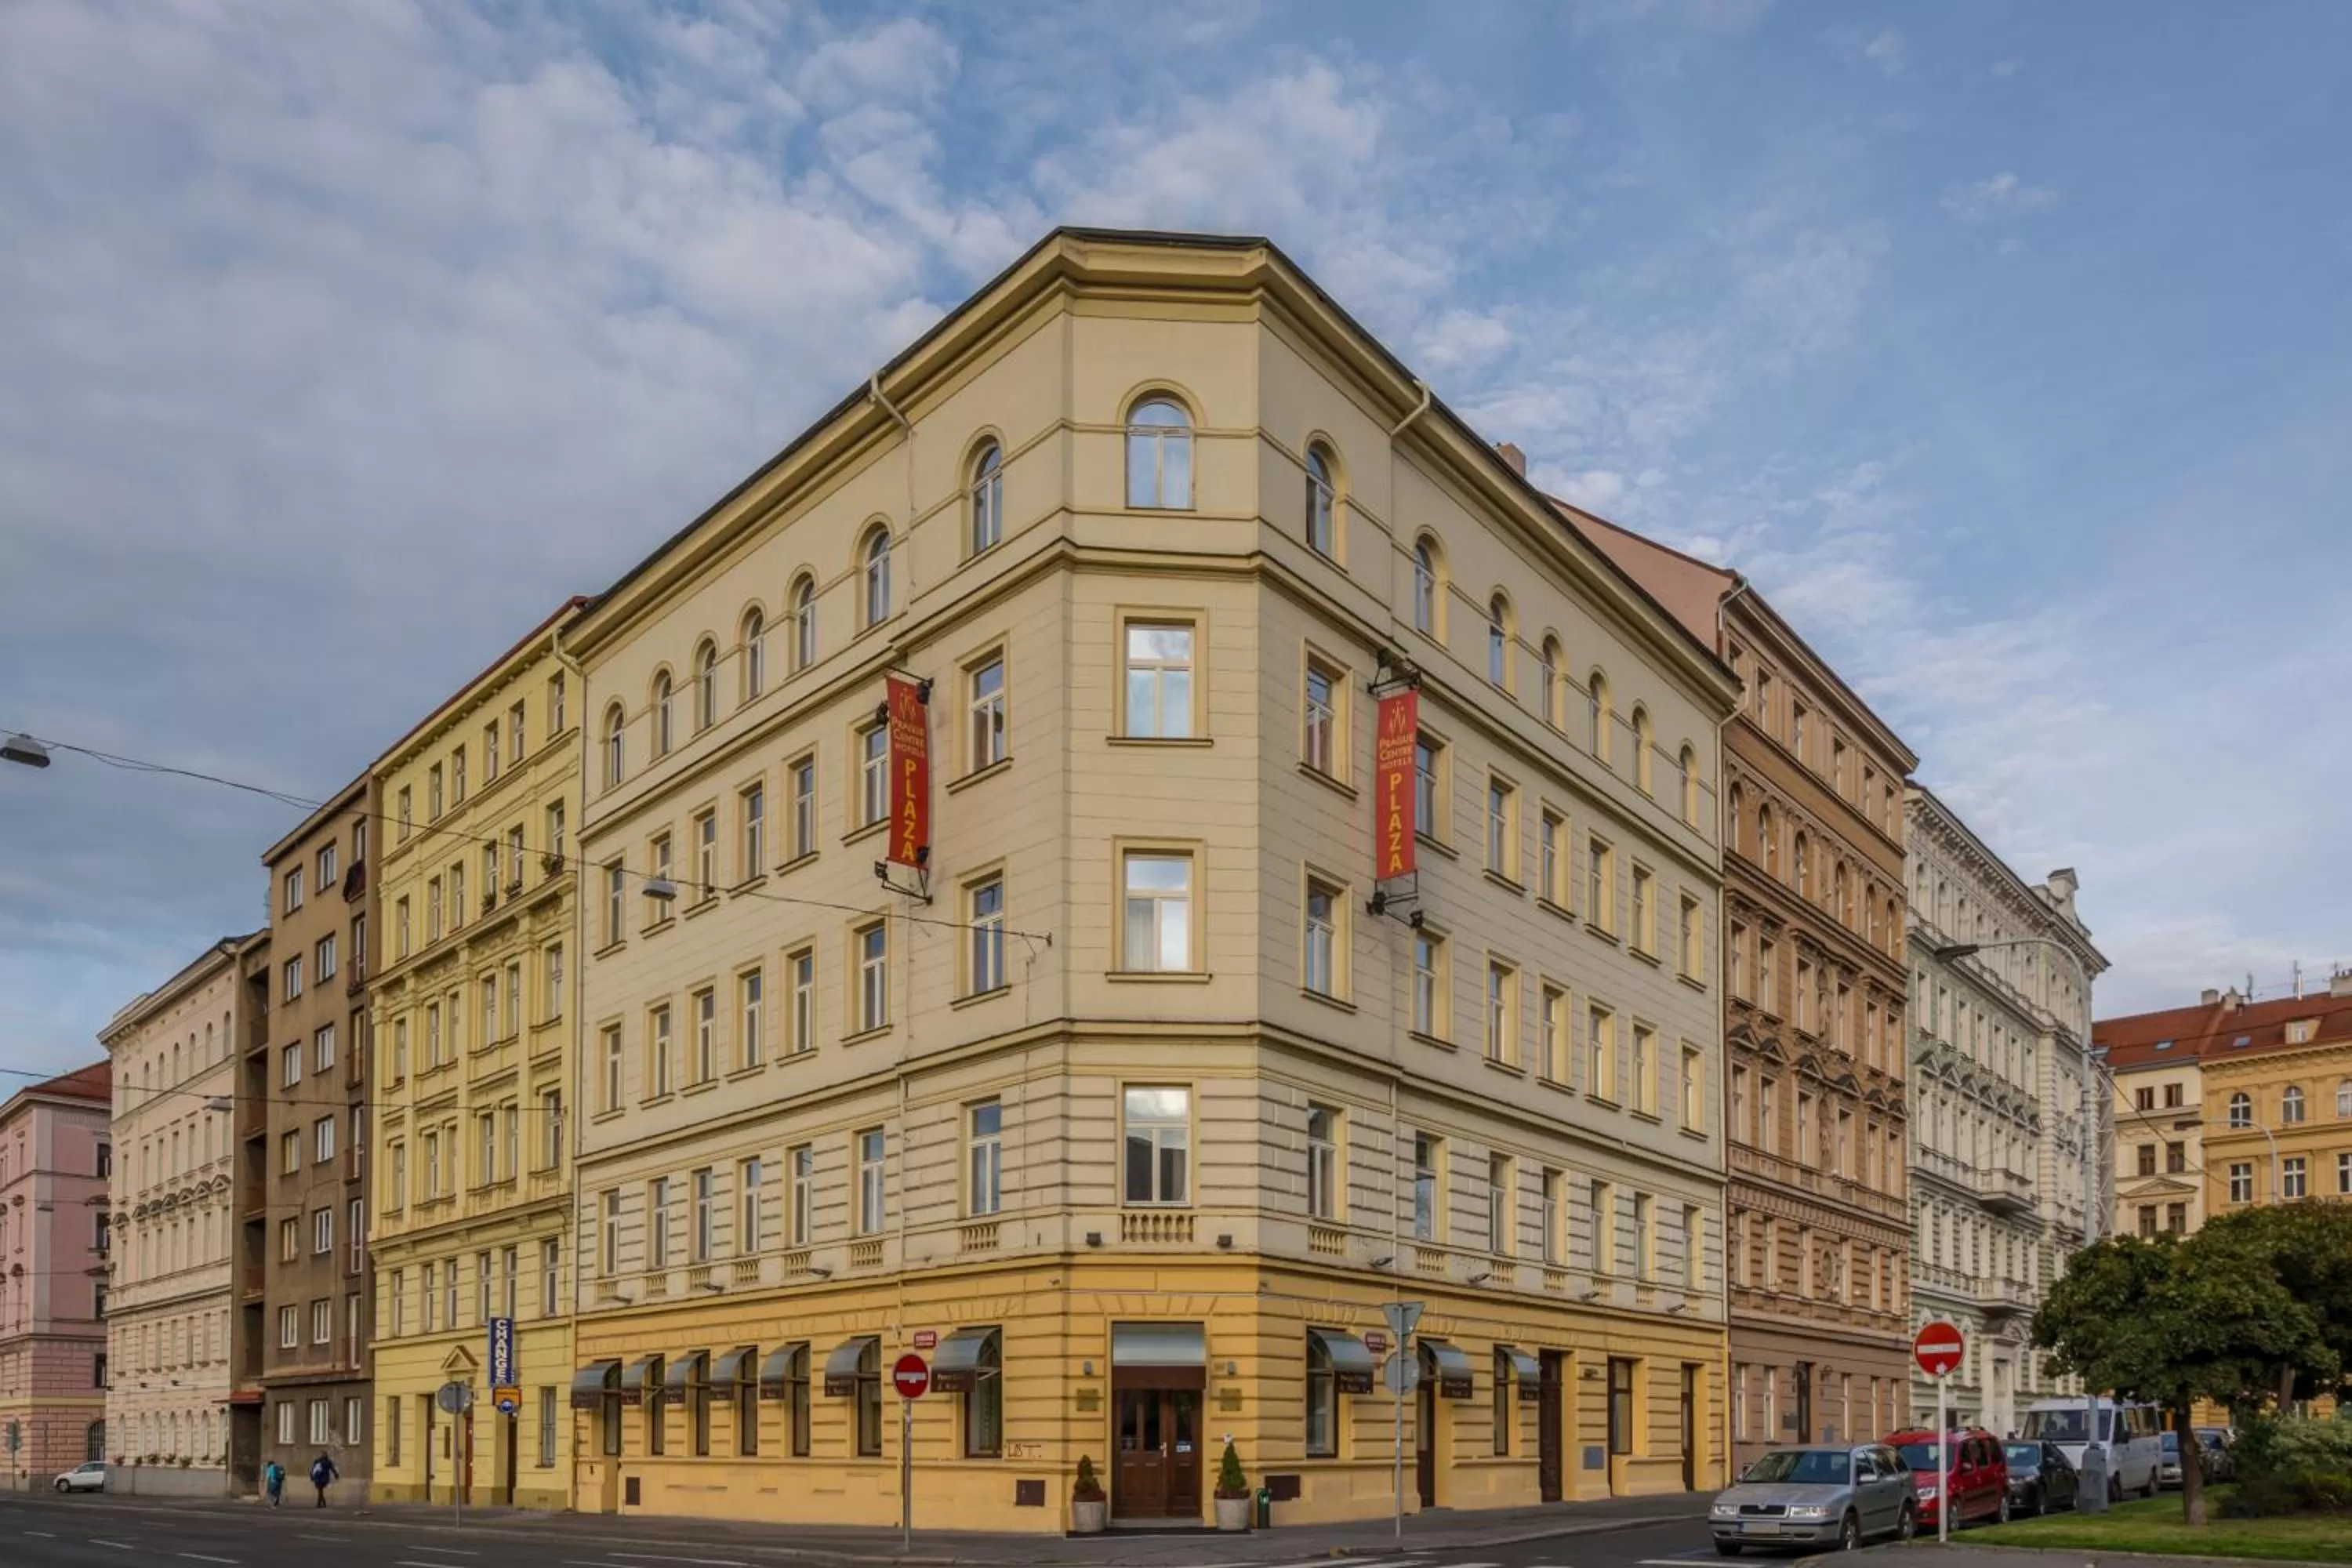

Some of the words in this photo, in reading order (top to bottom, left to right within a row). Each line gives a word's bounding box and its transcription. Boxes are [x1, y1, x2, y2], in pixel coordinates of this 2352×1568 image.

[902, 758, 916, 861] PLAZA
[1389, 772, 1403, 873] PLAZA
[495, 1319, 508, 1380] CHANGE
